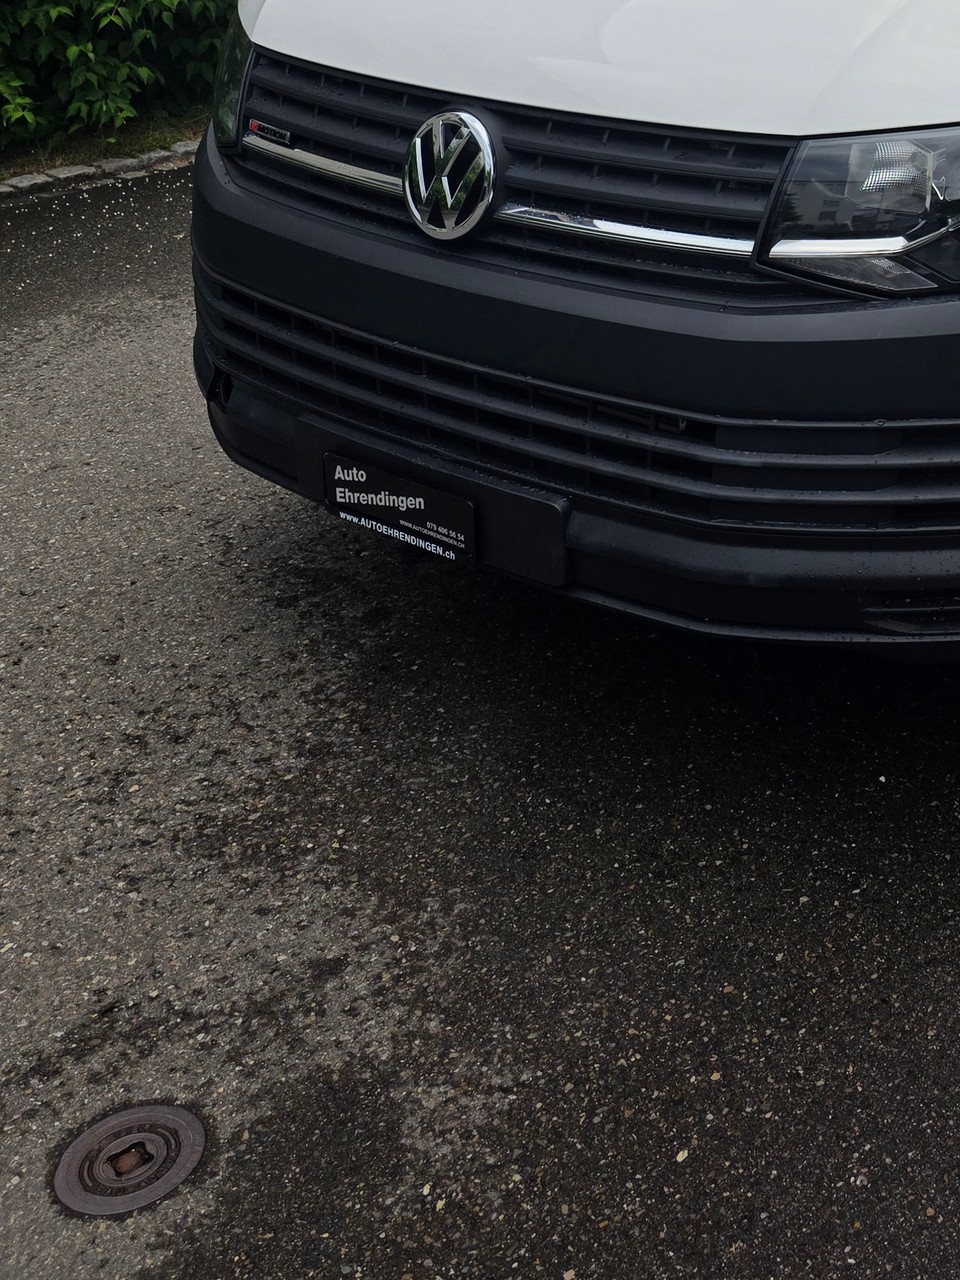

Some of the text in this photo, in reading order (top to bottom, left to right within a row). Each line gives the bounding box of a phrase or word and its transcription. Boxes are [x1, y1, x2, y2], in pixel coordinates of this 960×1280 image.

[334, 465, 367, 482] Auto
[335, 487, 425, 511] Ehrendingen
[339, 511, 456, 561] www.AUTOEHRENDINGEN.ch
[426, 521, 437, 531] 079
